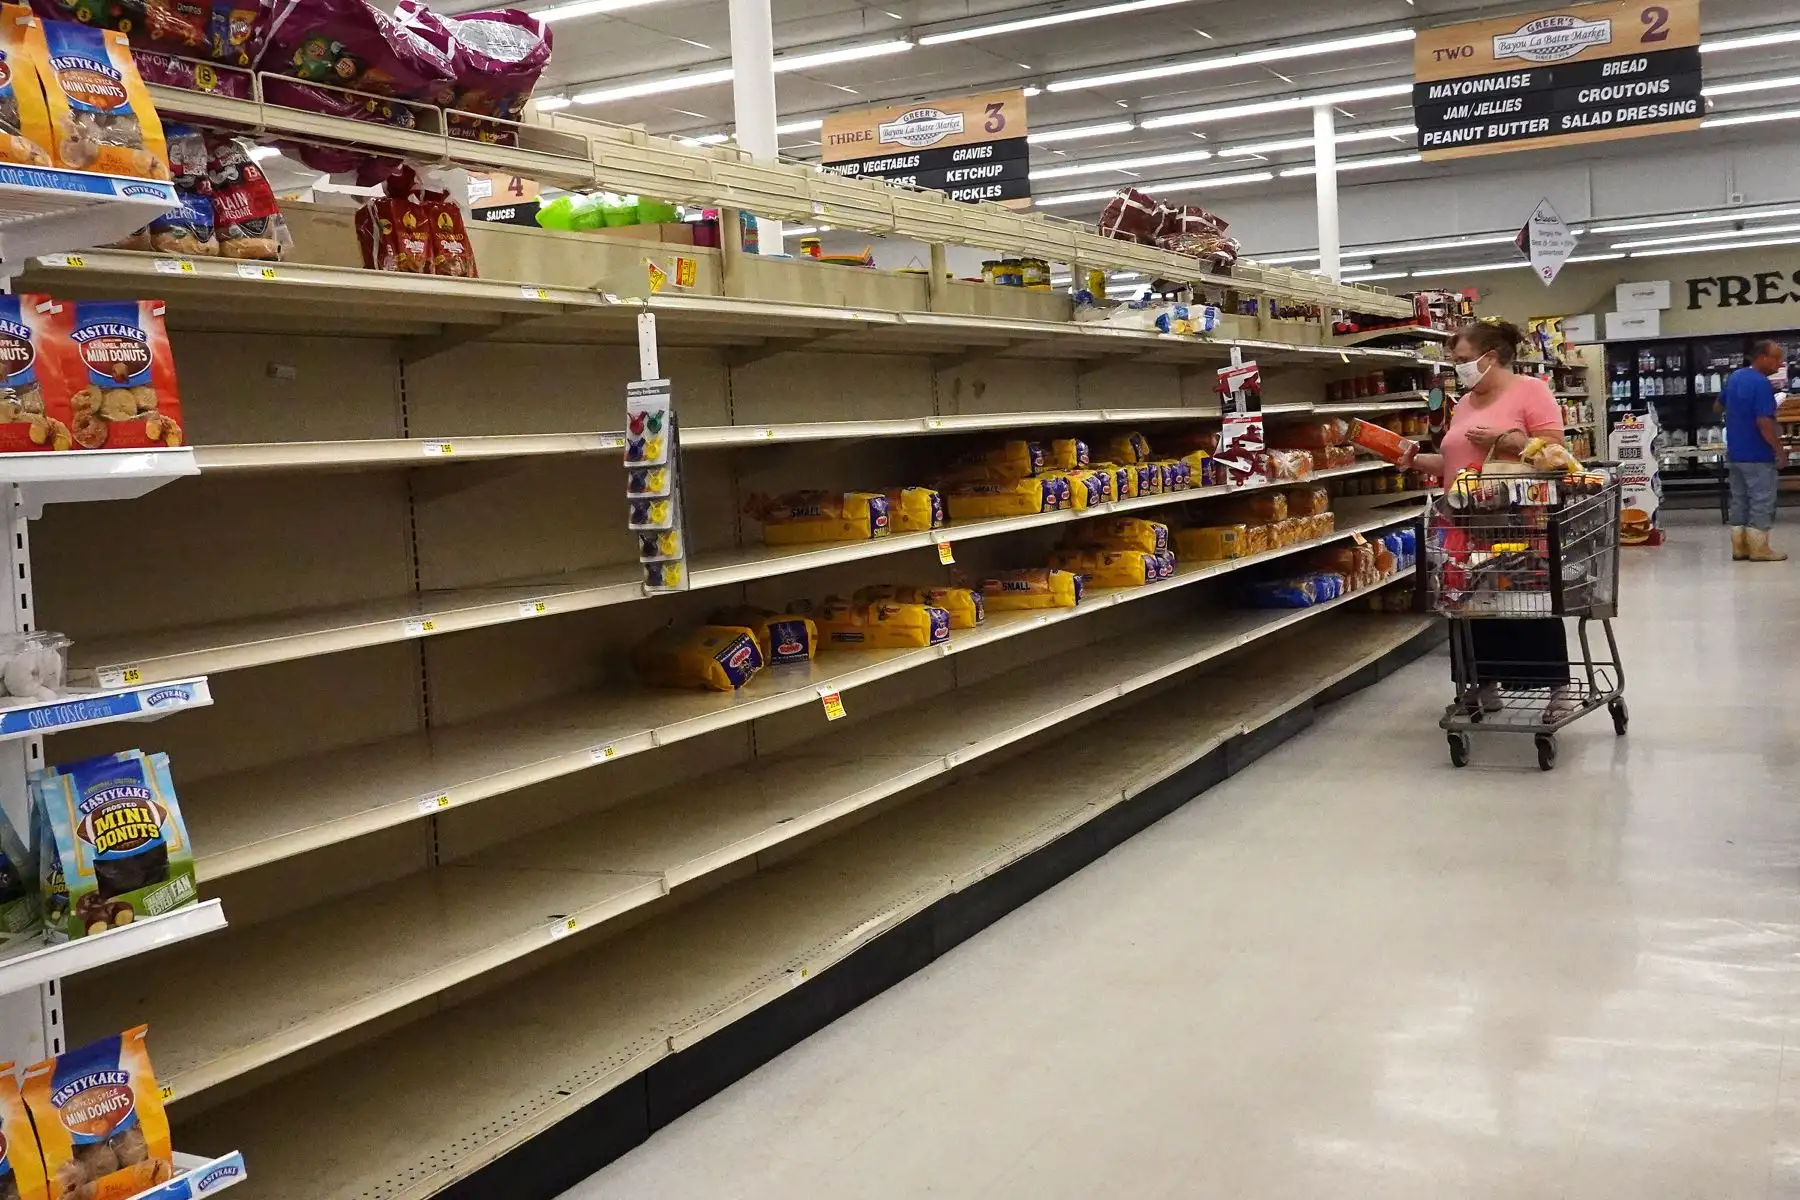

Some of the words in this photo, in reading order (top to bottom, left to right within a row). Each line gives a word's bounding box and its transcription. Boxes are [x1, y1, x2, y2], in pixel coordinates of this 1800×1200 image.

[1527, 17, 1575, 32] GREER'S
[1641, 7, 1669, 43] 2
[1499, 39, 1528, 53] Bayou
[1530, 35, 1542, 47] La
[1544, 33, 1570, 45] Batre
[1572, 27, 1606, 41] Market
[1433, 45, 1475, 61] TWO
[51, 56, 120, 80] TASTYKAKE
[1602, 58, 1649, 77] BREAD
[62, 80, 85, 92] MINI
[87, 84, 125, 98] DONUTS
[1429, 74, 1532, 99] MAYONNAISE
[1578, 79, 1671, 104] CROUTONS
[903, 110, 938, 122] GREER'S
[984, 102, 1007, 134] 3
[1443, 98, 1524, 121] JAM/JELLIES
[1561, 113, 1613, 130] SALAD
[1617, 101, 1698, 123] DRESSING
[936, 118, 961, 131] Market
[1423, 126, 1484, 146] PEANUT
[1488, 118, 1551, 137] BUTTER
[828, 129, 873, 146] THREE
[952, 145, 993, 162] GRAVIES
[863, 154, 921, 174] VEGETABLES
[946, 164, 1004, 183] KETCHUP
[124, 187, 166, 198] TASTYKAKE
[508, 175, 523, 197] 4
[951, 185, 1003, 202] PICKLES
[486, 208, 516, 221] SAUCES
[72, 324, 146, 342] TASTYKAKE
[87, 350, 109, 361] MINI
[111, 350, 148, 361] DONUTS
[89, 342, 117, 350] CARAMEL
[120, 342, 139, 350] APPLE
[1002, 580, 1031, 591] SMALL
[123, 670, 139, 681] 2.95
[149, 691, 189, 705] TASTYKAKE
[80, 787, 151, 814] TASTYKAKE
[102, 803, 137, 814] FROSTED
[94, 808, 151, 836] MINI
[96, 823, 160, 853] DONUTS
[173, 874, 193, 897] FAN
[52, 1072, 126, 1107] TASTYKAKE
[66, 1111, 87, 1126] MINI
[89, 1094, 129, 1118] DONUTS
[199, 1168, 237, 1188] TASTYKAKE
